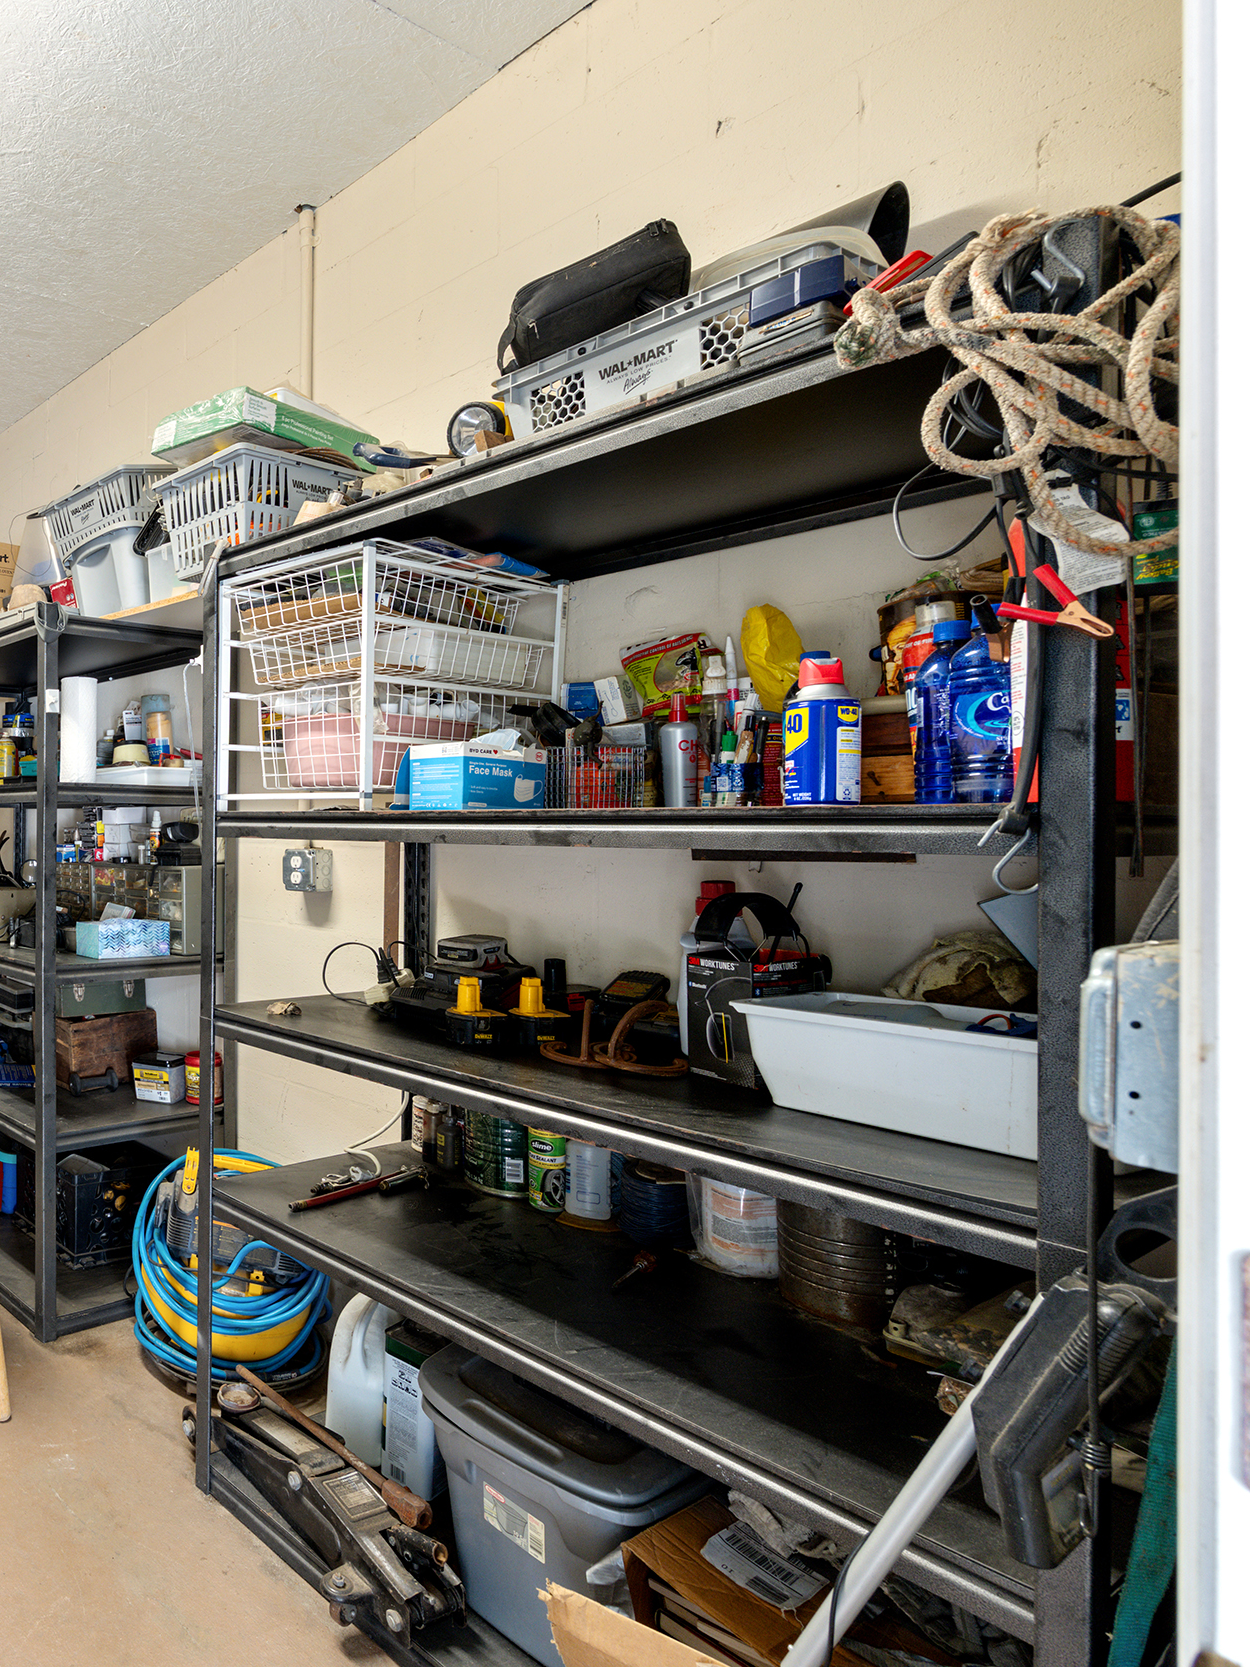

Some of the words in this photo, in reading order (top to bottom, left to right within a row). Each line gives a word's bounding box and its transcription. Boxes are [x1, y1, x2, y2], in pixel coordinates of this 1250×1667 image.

[606, 372, 629, 385] ALWAYS
[630, 366, 644, 375] LOW
[840, 707, 858, 716] WD-40
[469, 765, 490, 776] Face
[492, 766, 513, 778] Mask
[688, 956, 700, 966] 3M
[700, 958, 736, 971] WORKTUNES
[753, 963, 769, 973] 3M
[769, 961, 798, 972] WORKTUNES
[531, 1141, 552, 1151] slime
[536, 1154, 557, 1163] SEALANT
